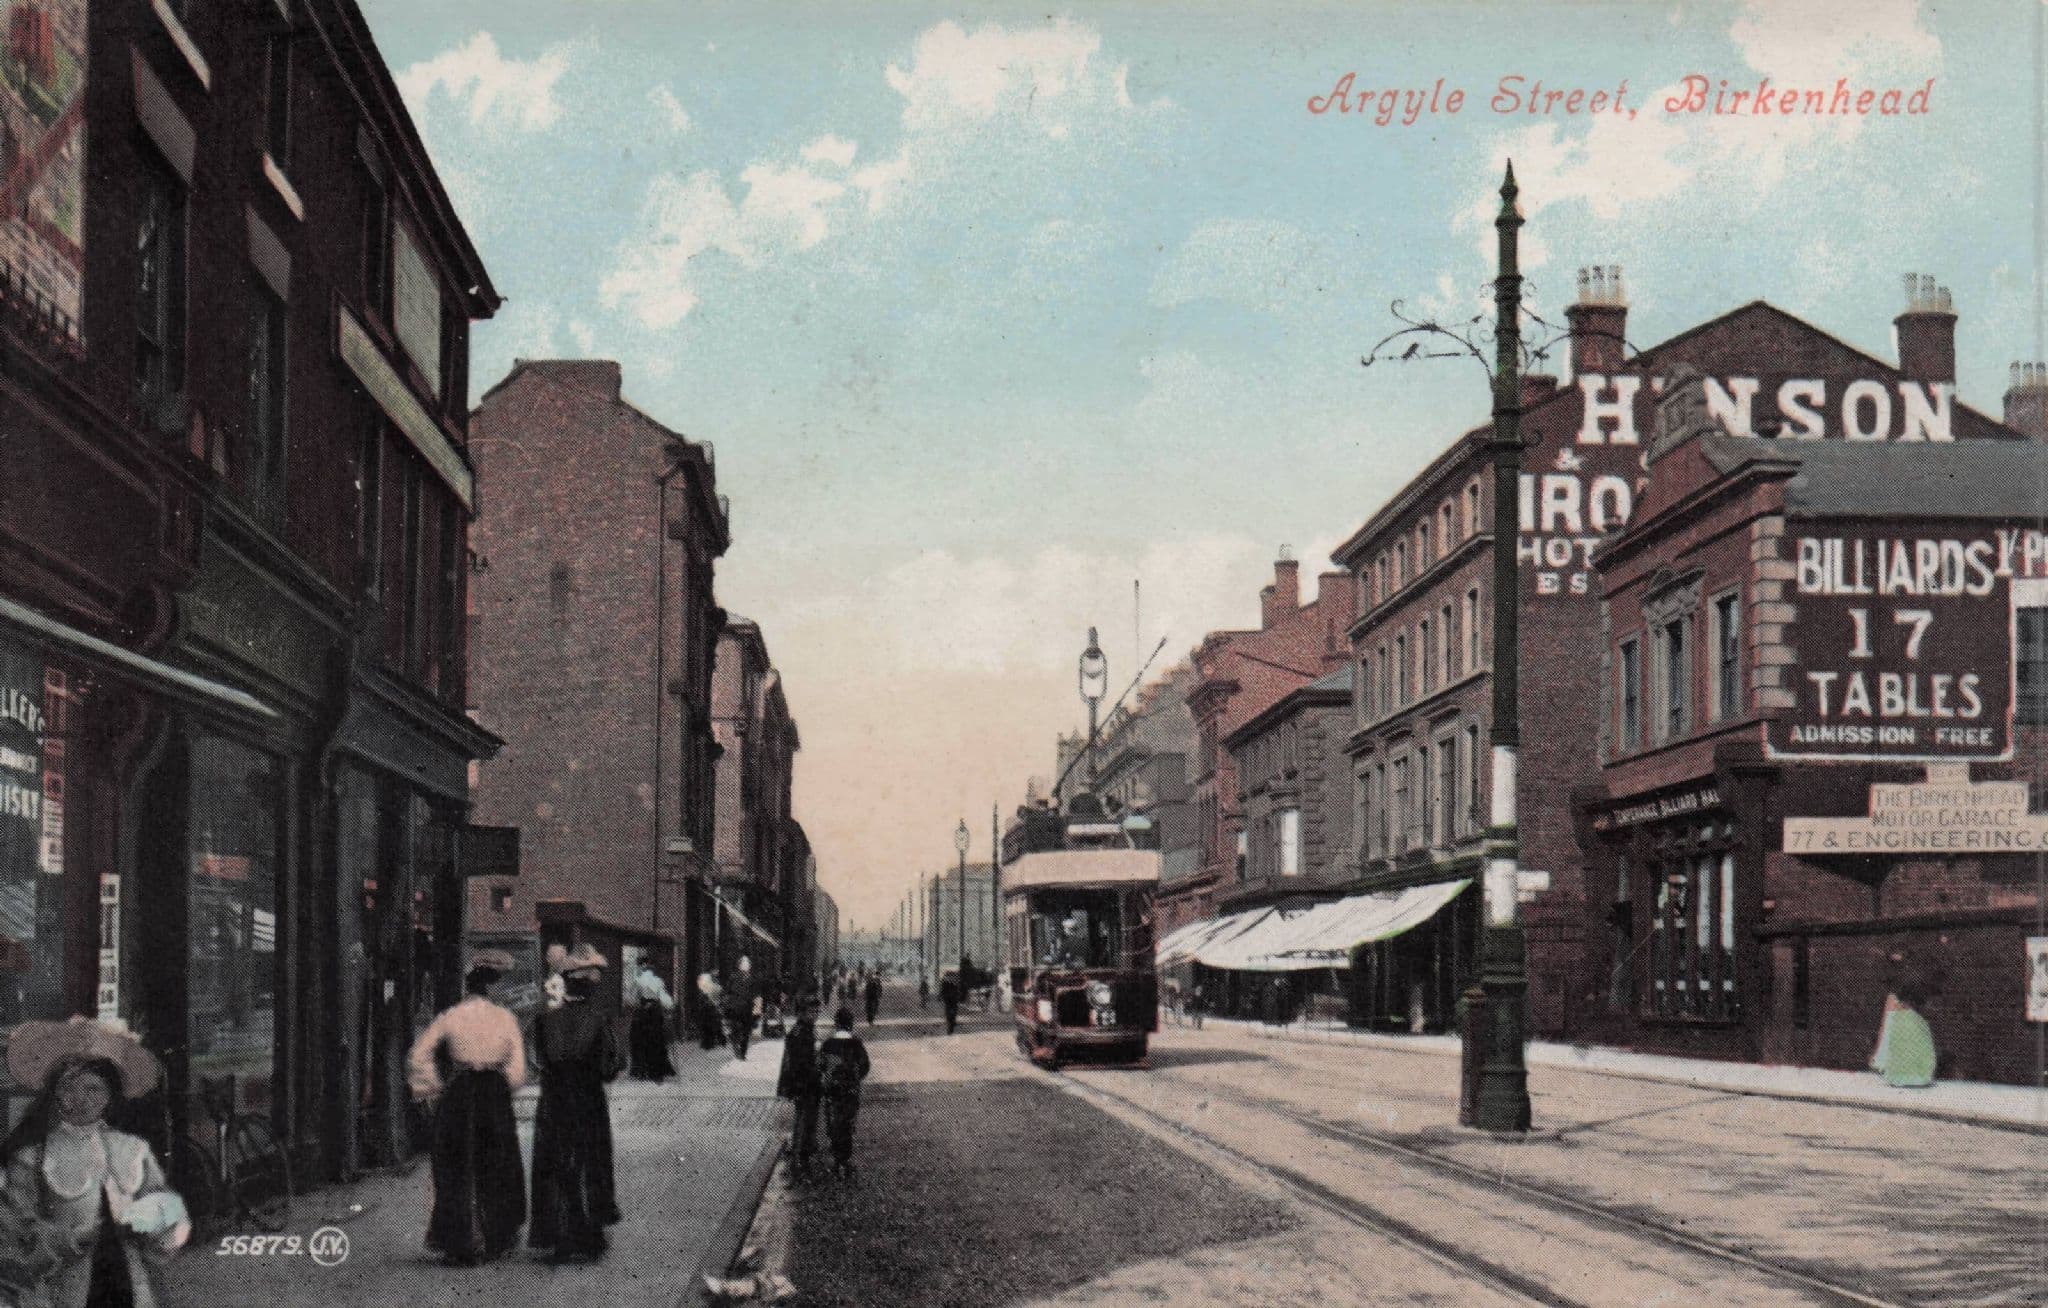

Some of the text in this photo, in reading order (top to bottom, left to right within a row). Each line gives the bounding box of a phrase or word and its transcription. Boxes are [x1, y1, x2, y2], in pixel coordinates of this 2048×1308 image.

[1576, 374, 1956, 444] HNSON
[1797, 538, 1996, 597] BILLIARDS
[1806, 671, 1983, 718] TABLES
[1790, 724, 1993, 747] ADMISSION FREE
[1871, 808, 2020, 828] MOTOR GARAGE
[1822, 830, 1841, 849] &
[1848, 830, 2033, 850] ENGINEERING
